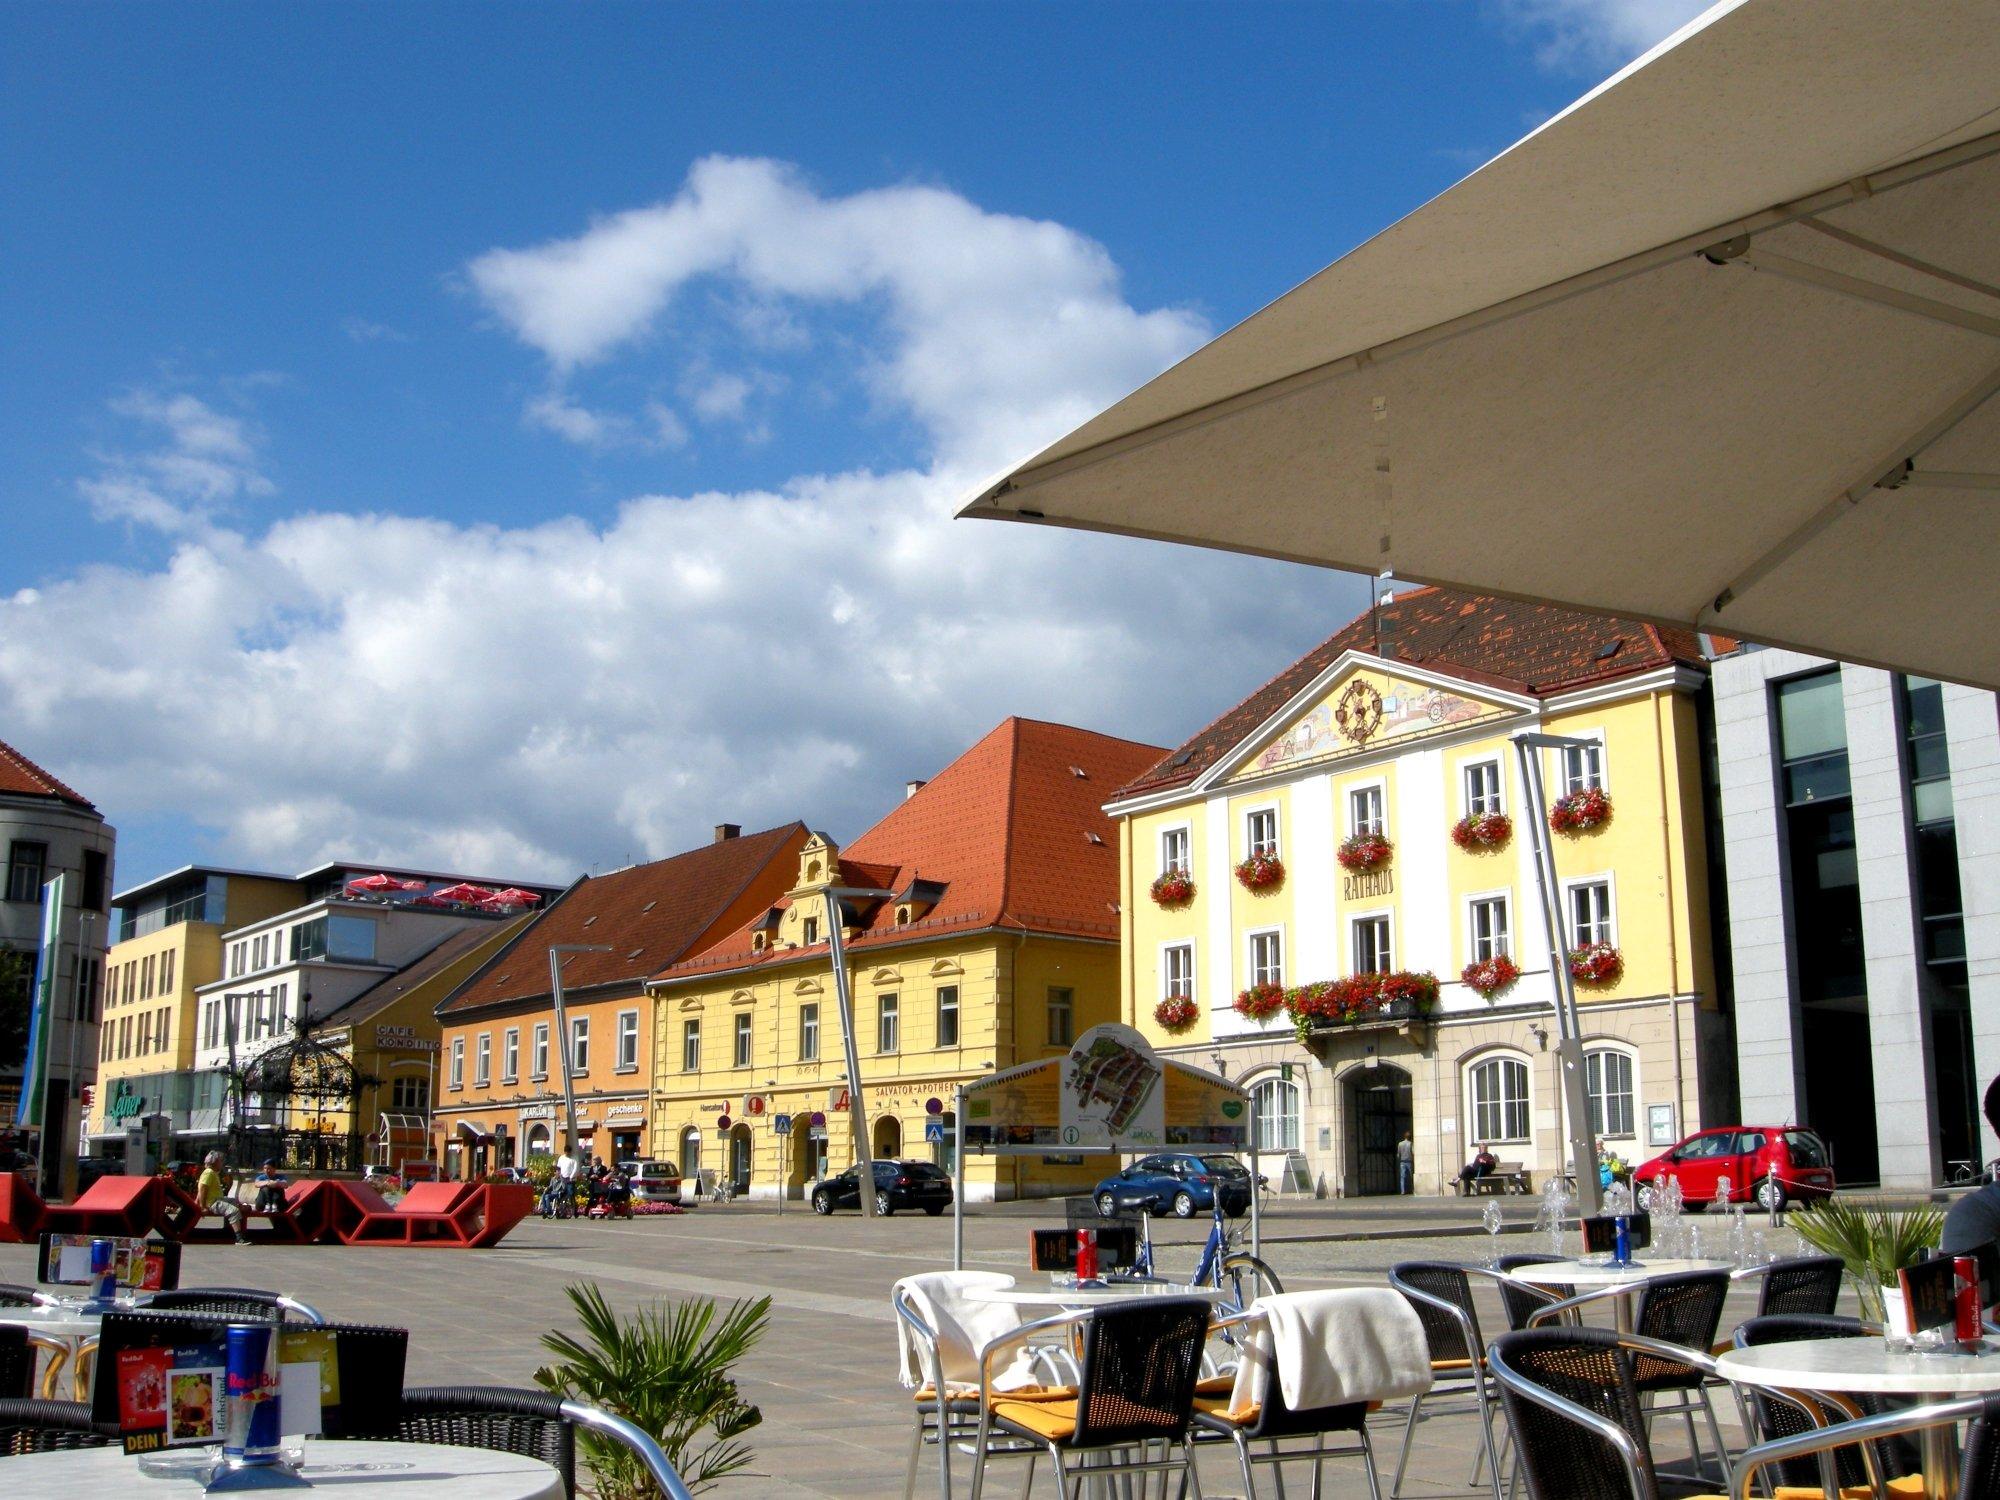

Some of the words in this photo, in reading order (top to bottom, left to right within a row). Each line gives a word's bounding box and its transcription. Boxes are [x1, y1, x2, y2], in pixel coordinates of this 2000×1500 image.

[1343, 869, 1394, 901] RATHAUS
[378, 1027, 415, 1037] CAFE
[607, 1103, 643, 1117] geschenke
[127, 1433, 158, 1451] DEIN
